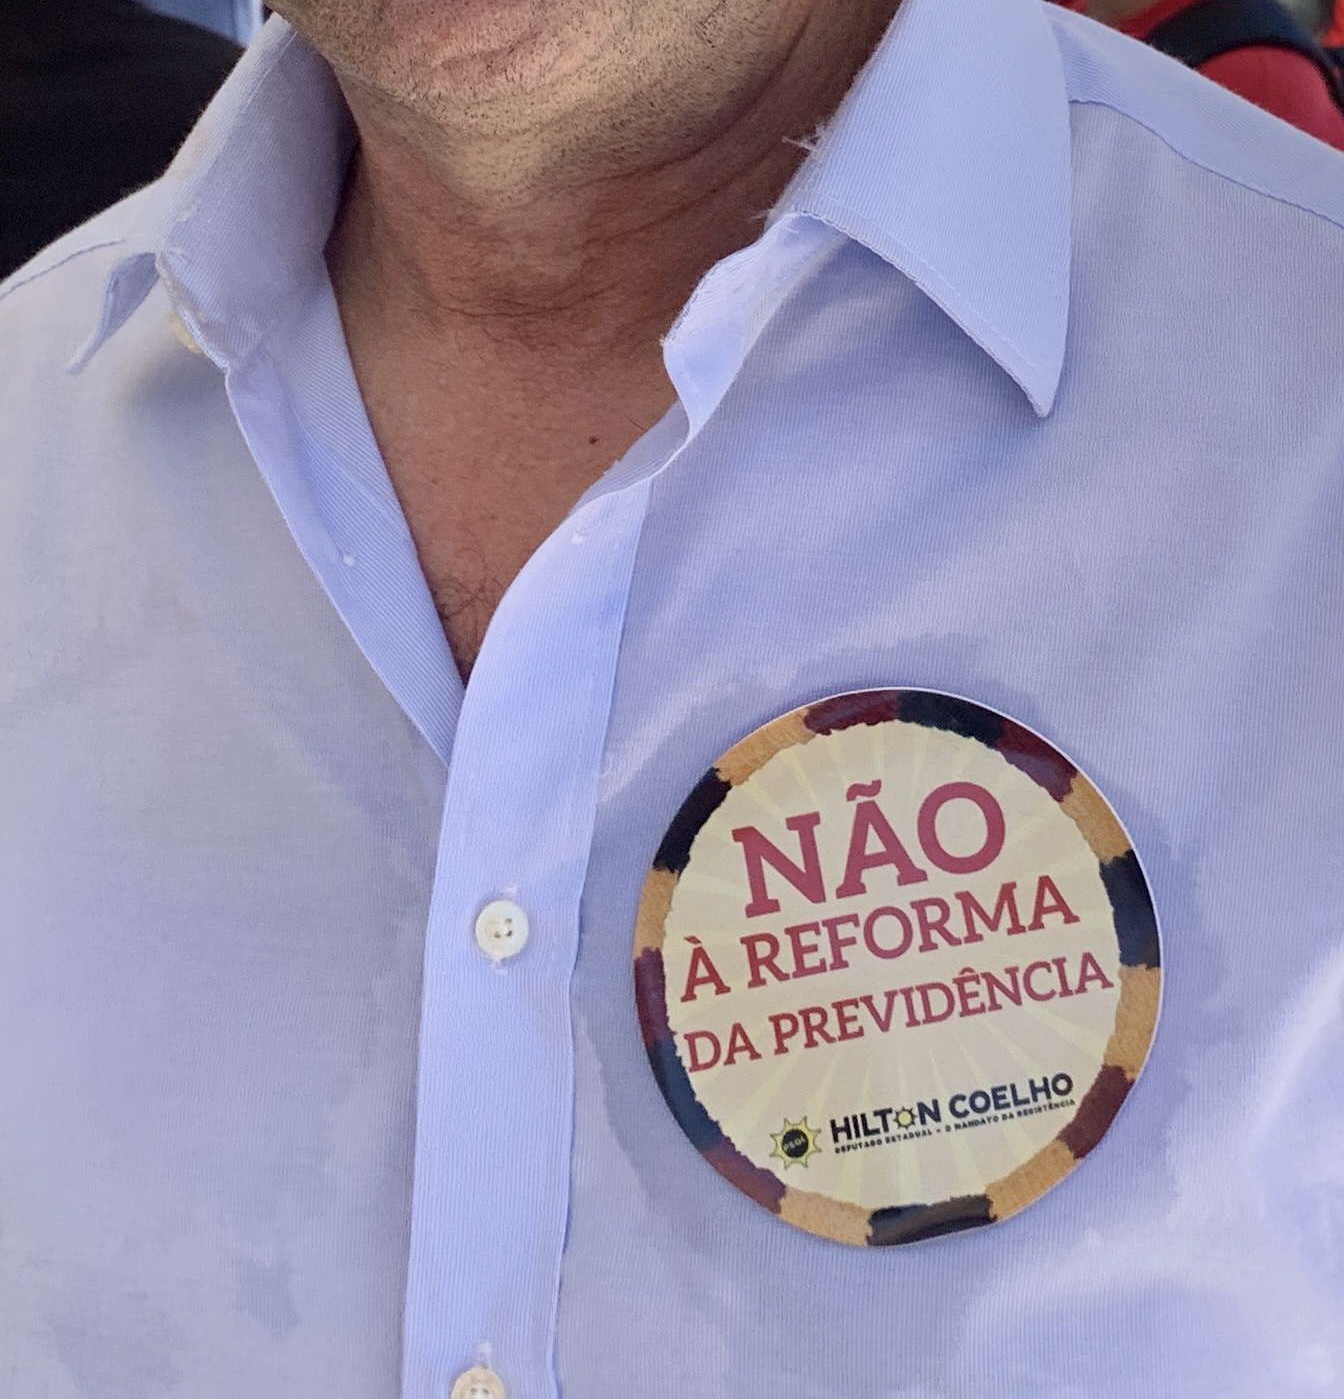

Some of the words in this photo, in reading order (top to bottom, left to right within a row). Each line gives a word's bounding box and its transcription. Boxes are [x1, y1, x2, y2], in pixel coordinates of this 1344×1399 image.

[732, 779, 1007, 918] NÃO
[681, 937, 730, 1003] À
[740, 875, 1080, 989] REFORMA
[684, 1023, 761, 1072] DA
[769, 952, 1114, 1056] PREVIDÊNCIA
[829, 1098, 941, 1143] HILTON
[949, 1073, 1073, 1119] COELHO
[834, 1138, 882, 1154] DEPUTADO
